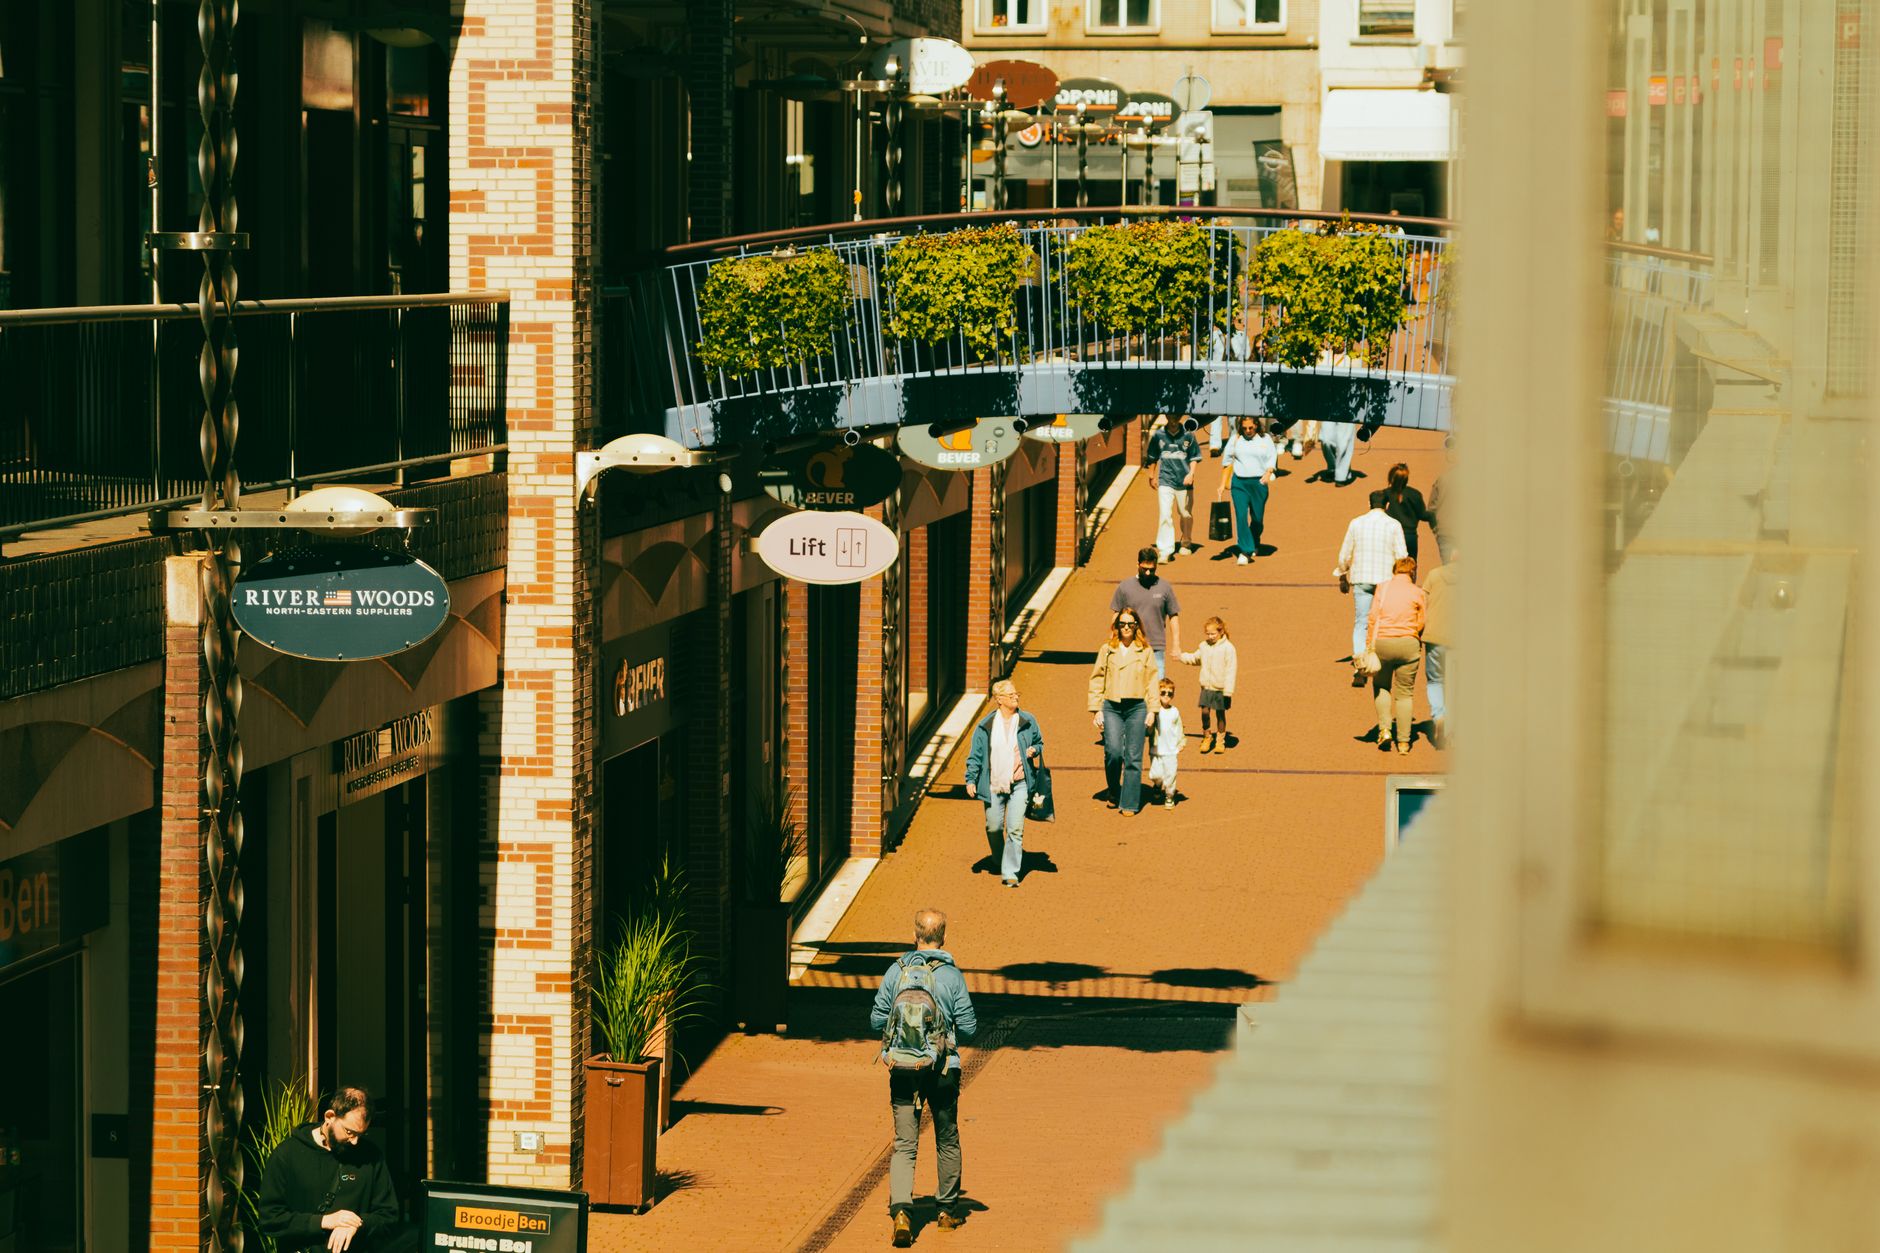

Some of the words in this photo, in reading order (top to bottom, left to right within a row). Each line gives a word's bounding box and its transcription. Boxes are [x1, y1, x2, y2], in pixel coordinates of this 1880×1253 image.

[1035, 427, 1075, 440] BEVER
[937, 451, 981, 464] BEVER
[805, 492, 855, 505] BEVER
[789, 537, 826, 557] Lift
[245, 590, 321, 606] RIVER
[355, 590, 435, 607] WOODS
[265, 607, 352, 616] NORTH-EASTERN
[355, 608, 413, 616] SUPPLIERS
[343, 729, 380, 776] RIVER
[392, 710, 433, 755] WOODS
[0, 868, 49, 942] Ben
[460, 1211, 515, 1229] Broodje
[518, 1215, 547, 1231] Ben
[434, 1232, 497, 1251] Bruine
